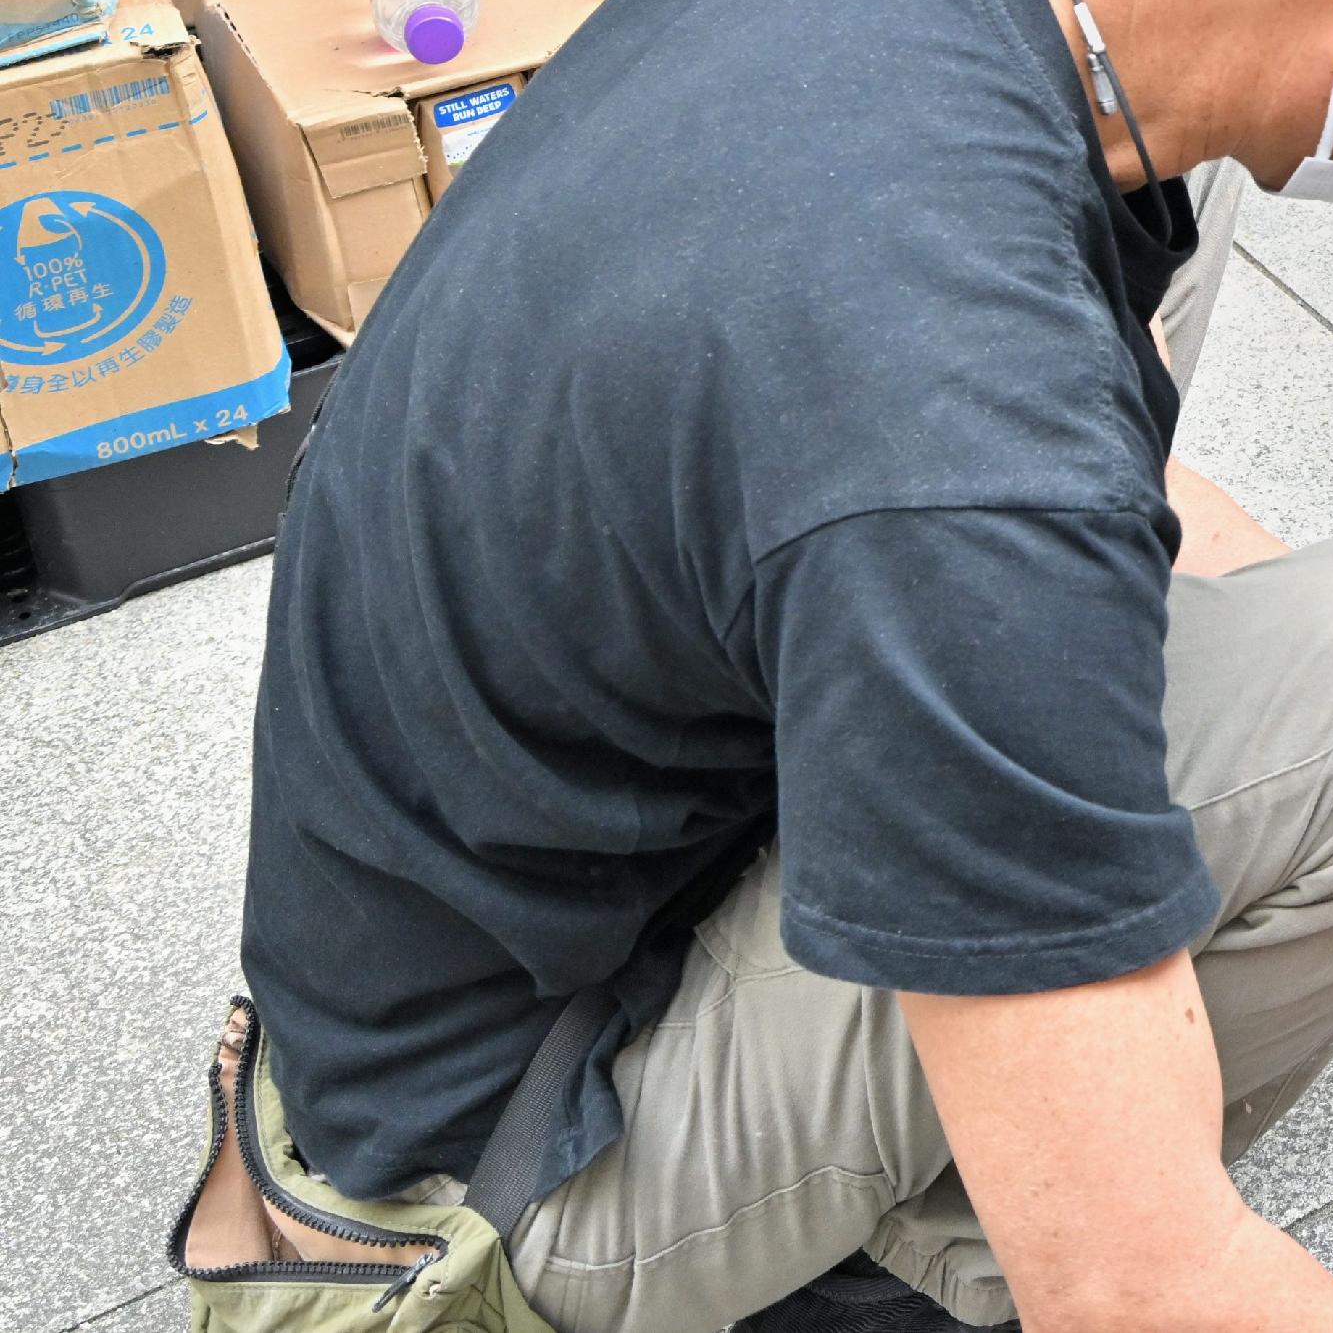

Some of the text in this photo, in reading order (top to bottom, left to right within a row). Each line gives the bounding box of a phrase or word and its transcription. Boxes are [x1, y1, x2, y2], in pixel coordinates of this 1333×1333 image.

[438, 86, 510, 116] STILL WATERS
[452, 100, 502, 123] RUN DEEP
[23, 254, 84, 282] 100%
[96, 404, 249, 459] 800mL x 24
